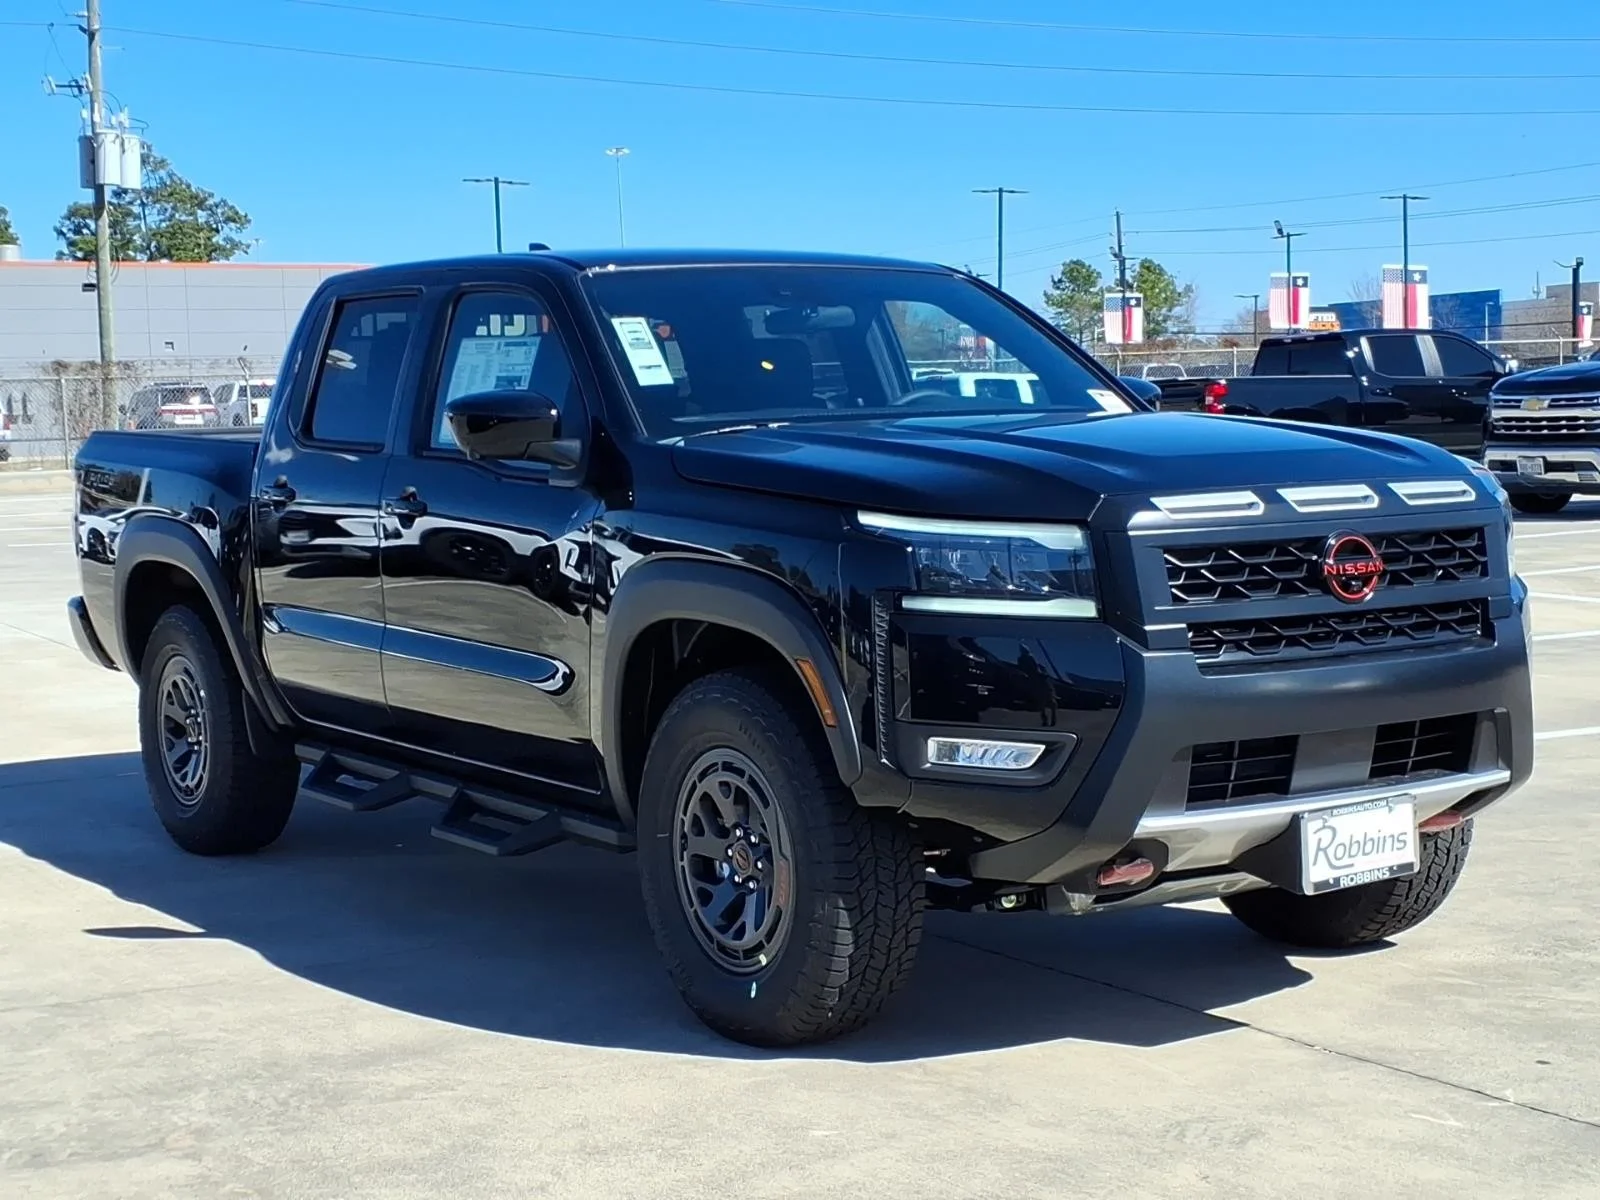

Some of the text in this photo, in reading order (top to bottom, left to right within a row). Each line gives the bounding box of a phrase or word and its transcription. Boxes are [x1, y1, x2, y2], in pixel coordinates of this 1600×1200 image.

[1324, 561, 1383, 575] NISSAN
[1312, 824, 1408, 870] Robbins
[1339, 867, 1391, 888] ROBBINS
